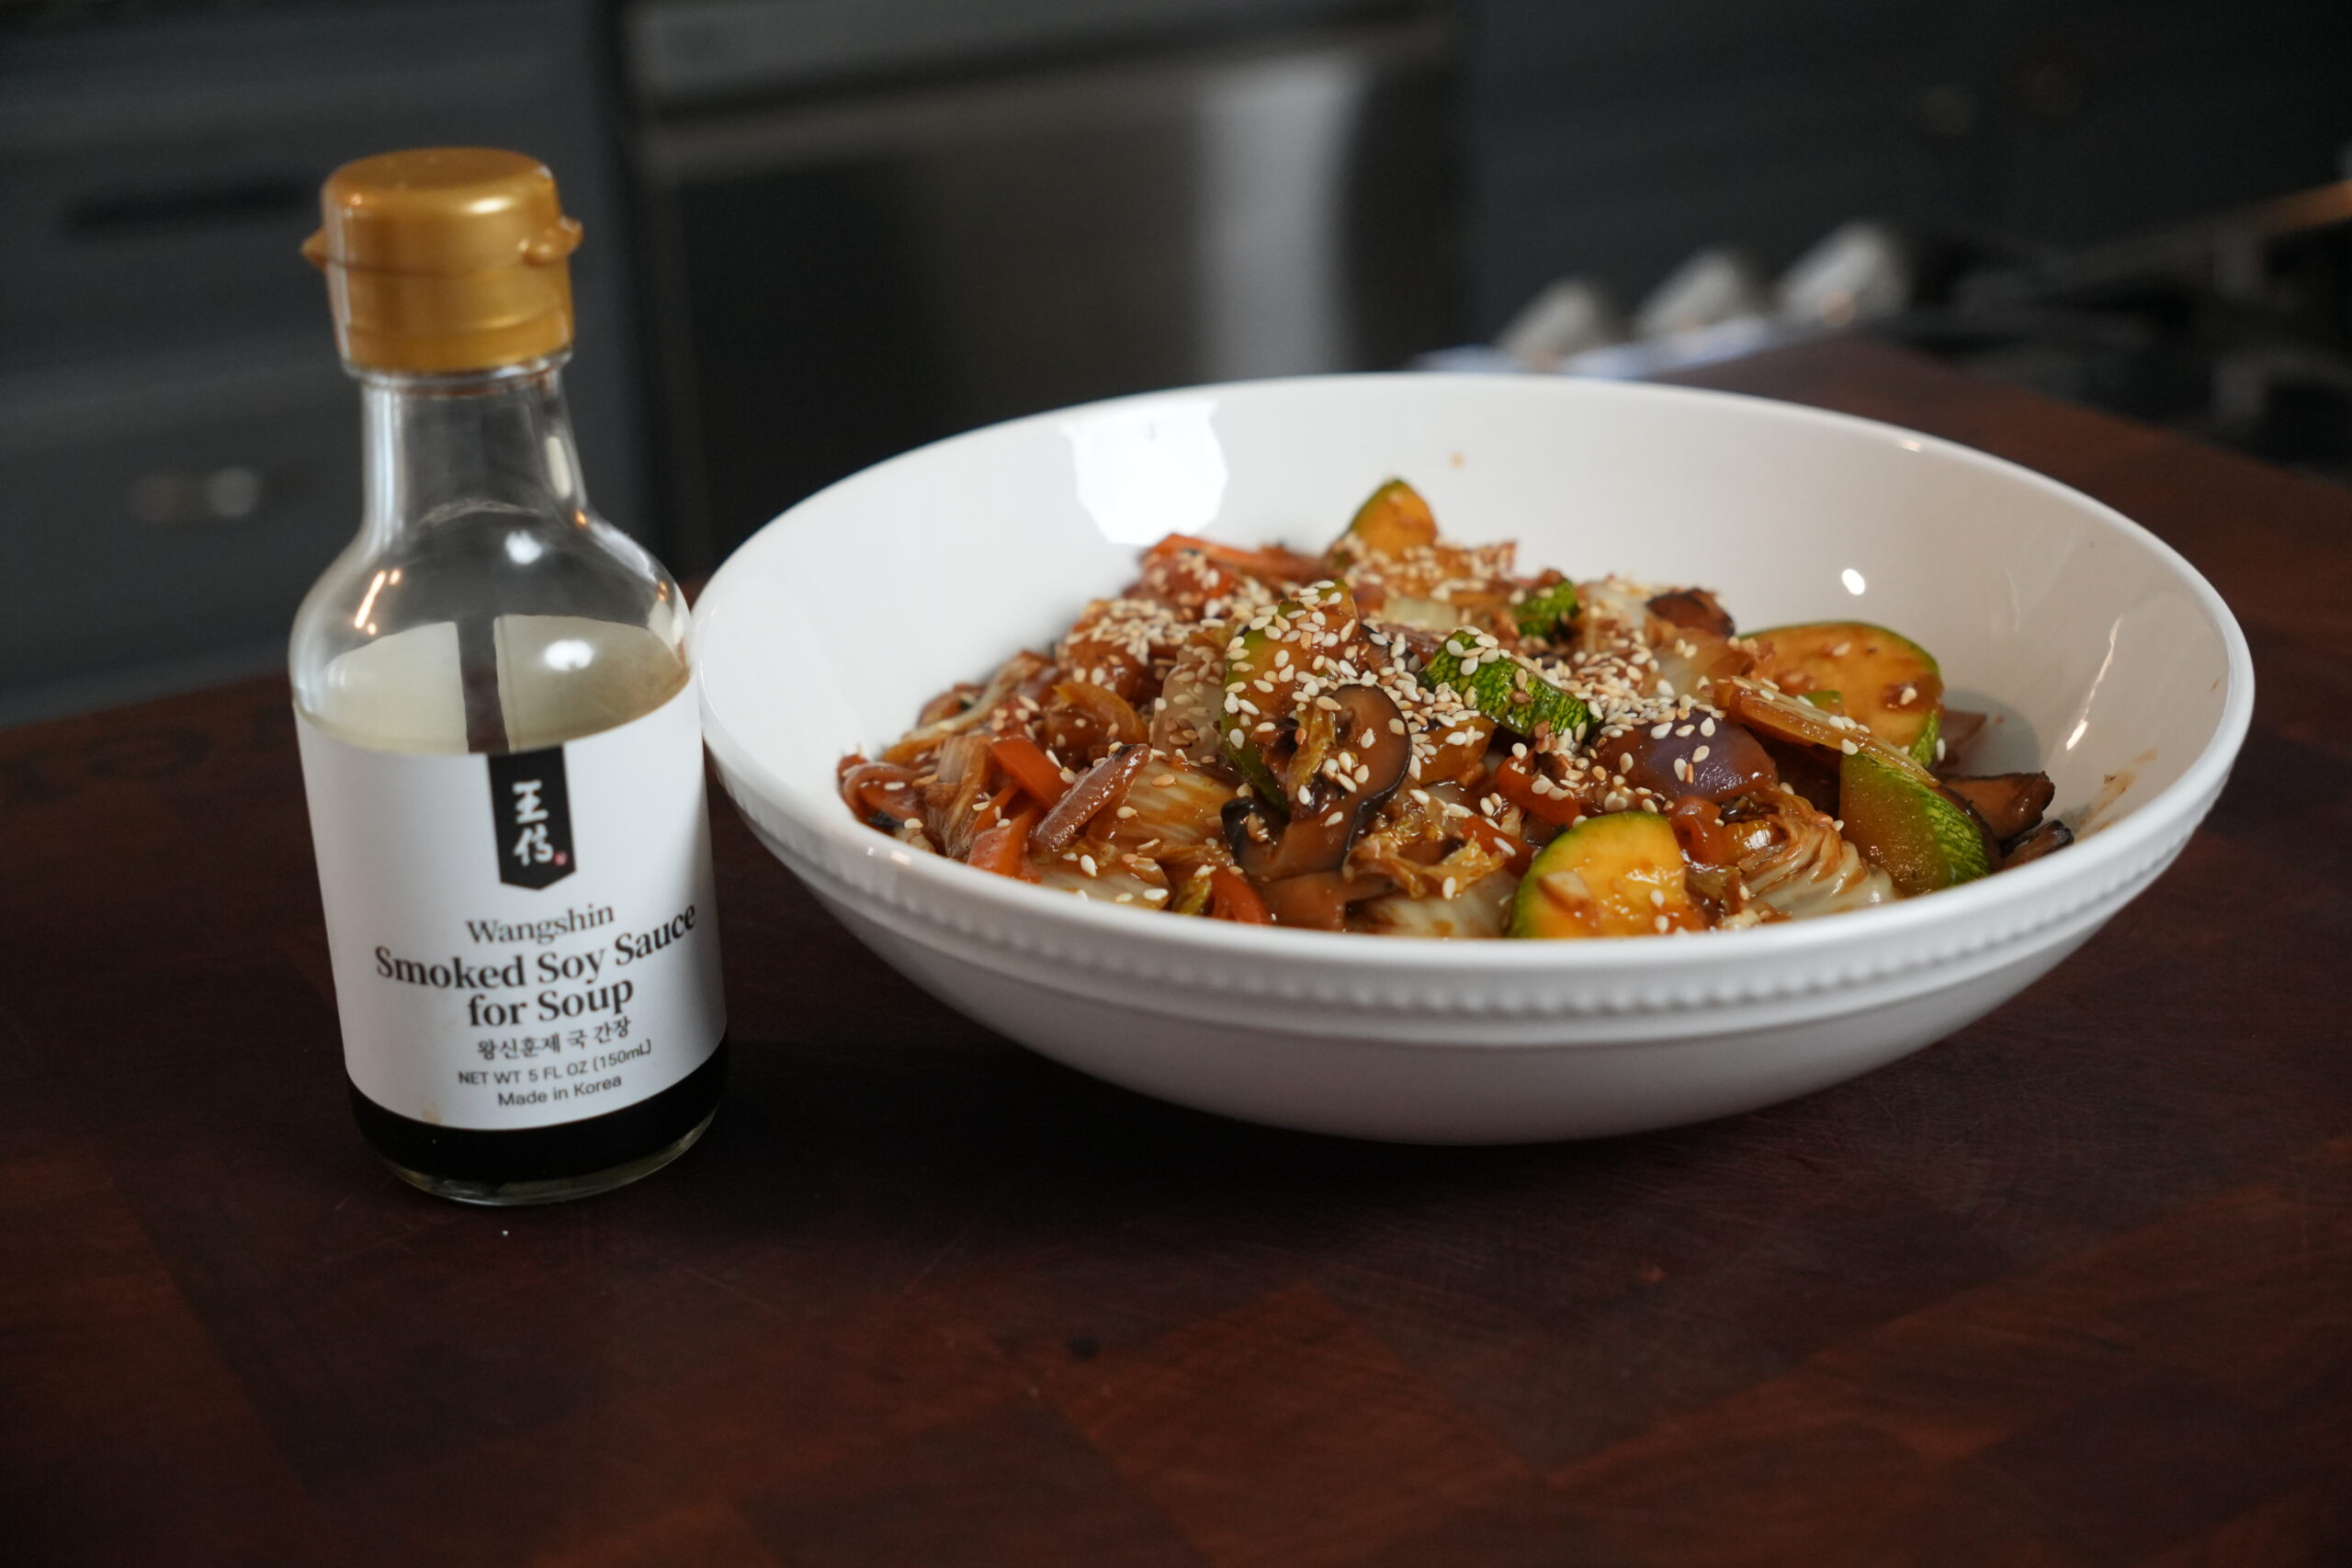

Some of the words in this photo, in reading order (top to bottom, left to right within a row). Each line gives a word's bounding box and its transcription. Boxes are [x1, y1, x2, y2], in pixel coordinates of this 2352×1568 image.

[374, 945, 527, 988] Smoked
[537, 948, 606, 985] Soy
[615, 905, 696, 965] Sauce
[466, 903, 615, 944] Wangshin
[468, 993, 528, 1027] for
[537, 979, 634, 1021] Soup
[458, 1070, 489, 1084] NET
[493, 1070, 521, 1084] WT
[529, 1068, 538, 1082] 5
[544, 1066, 562, 1080] FL
[567, 1060, 588, 1077] OZ
[593, 1038, 652, 1072] (150mL)
[478, 1032, 561, 1061] 왕신훈제
[567, 1029, 588, 1049] 국
[594, 1015, 632, 1044] 간장
[498, 1090, 548, 1106] Made
[553, 1088, 569, 1100] in
[573, 1075, 623, 1097] Korea
